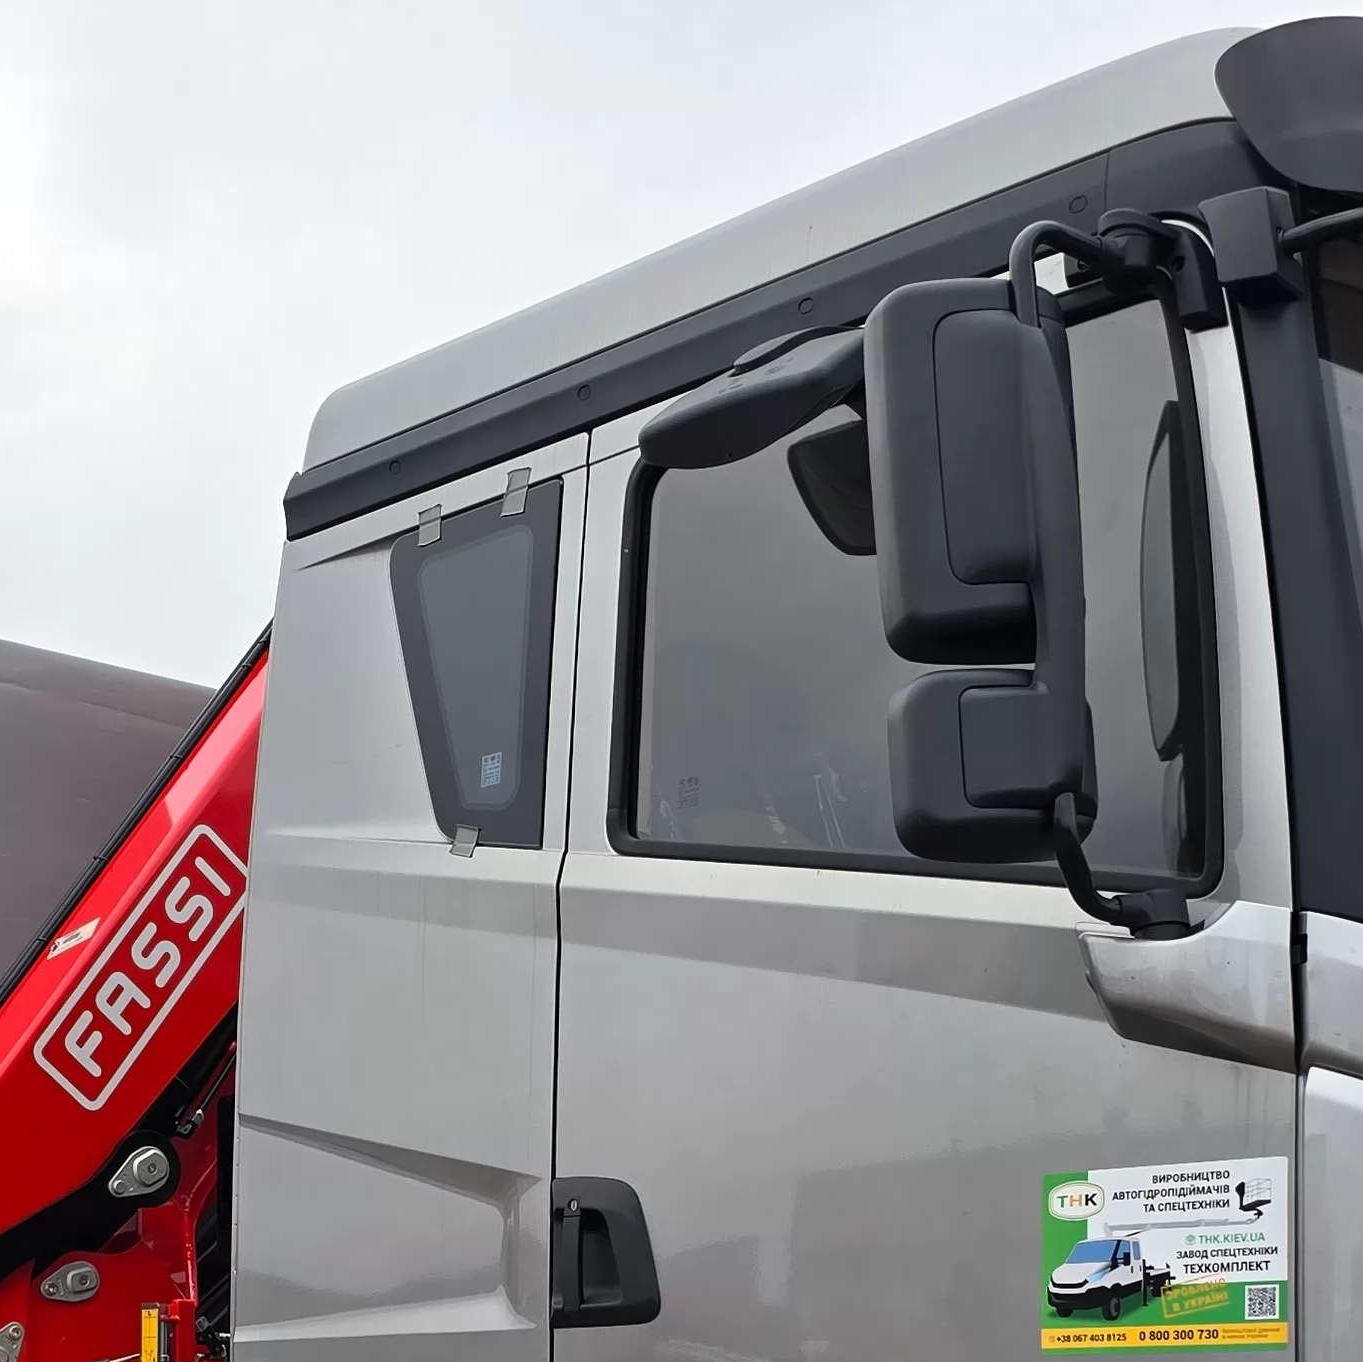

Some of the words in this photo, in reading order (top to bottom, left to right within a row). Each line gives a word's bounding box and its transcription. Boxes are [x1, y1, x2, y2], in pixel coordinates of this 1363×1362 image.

[65, 857, 231, 1077] FASSI
[1152, 1170, 1230, 1184] ВИРОБНИЦТВО
[1112, 1185, 1230, 1200] АВТОГІДРОПІДІЙМАЧІВ
[1143, 1204, 1155, 1213] ТА
[1157, 1199, 1230, 1213] СПЕЦТЕХНІКИ
[1176, 1250, 1208, 1260] ЗАВОД
[1210, 1246, 1278, 1258] СПЕЦТЕХНІКИ
[1183, 1260, 1271, 1274] ТЕХКОМПЛЕКТ
[1139, 1330, 1146, 1341] 0
[1149, 1330, 1170, 1341] 800
[1173, 1329, 1194, 1340] 300
[1197, 1329, 1219, 1340] 730
